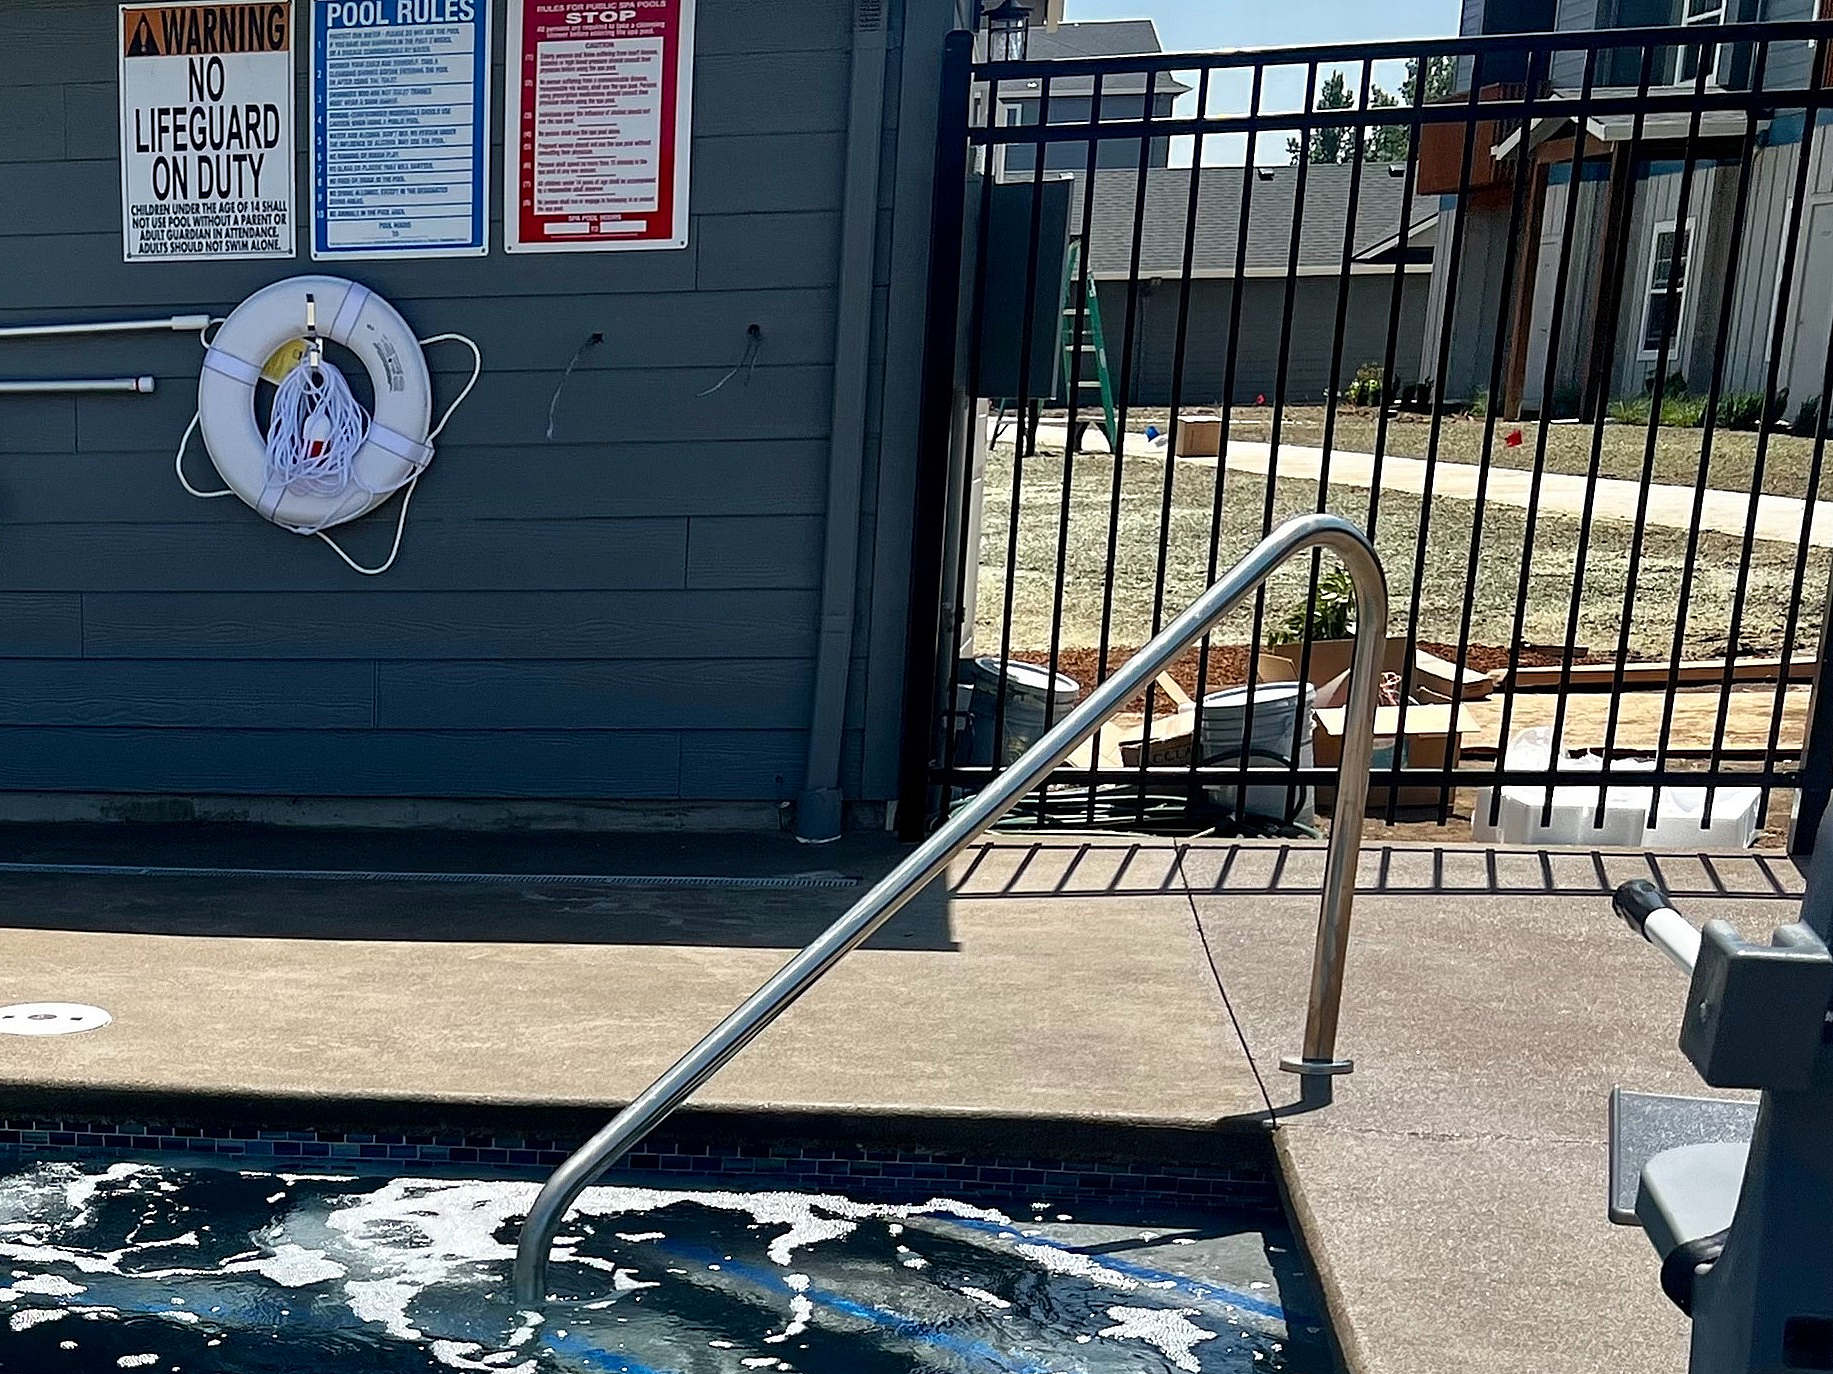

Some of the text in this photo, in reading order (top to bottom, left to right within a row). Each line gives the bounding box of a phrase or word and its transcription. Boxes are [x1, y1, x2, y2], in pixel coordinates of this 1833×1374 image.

[327, 0, 475, 27] POOL RULES
[536, 5, 564, 13] RULES
[565, 10, 637, 24] STOP
[160, 5, 284, 54] WARNING
[189, 56, 225, 102] NO
[135, 104, 280, 152] LIFEGUARD
[152, 153, 264, 200] ON DUTY
[131, 201, 287, 216] CHILDREN UNDER THE AGE OF 14 SHALL
[133, 214, 286, 228] NOT USE POOL WITHOUT A PARENT OR
[140, 229, 164, 241] ADULT
[168, 228, 210, 240] GUARDIAN
[213, 228, 222, 239] IN
[139, 242, 167, 253] ADULTS
[170, 241, 203, 252] SHOULD
[206, 241, 223, 251] NOT
[226, 240, 248, 251] SWIM
